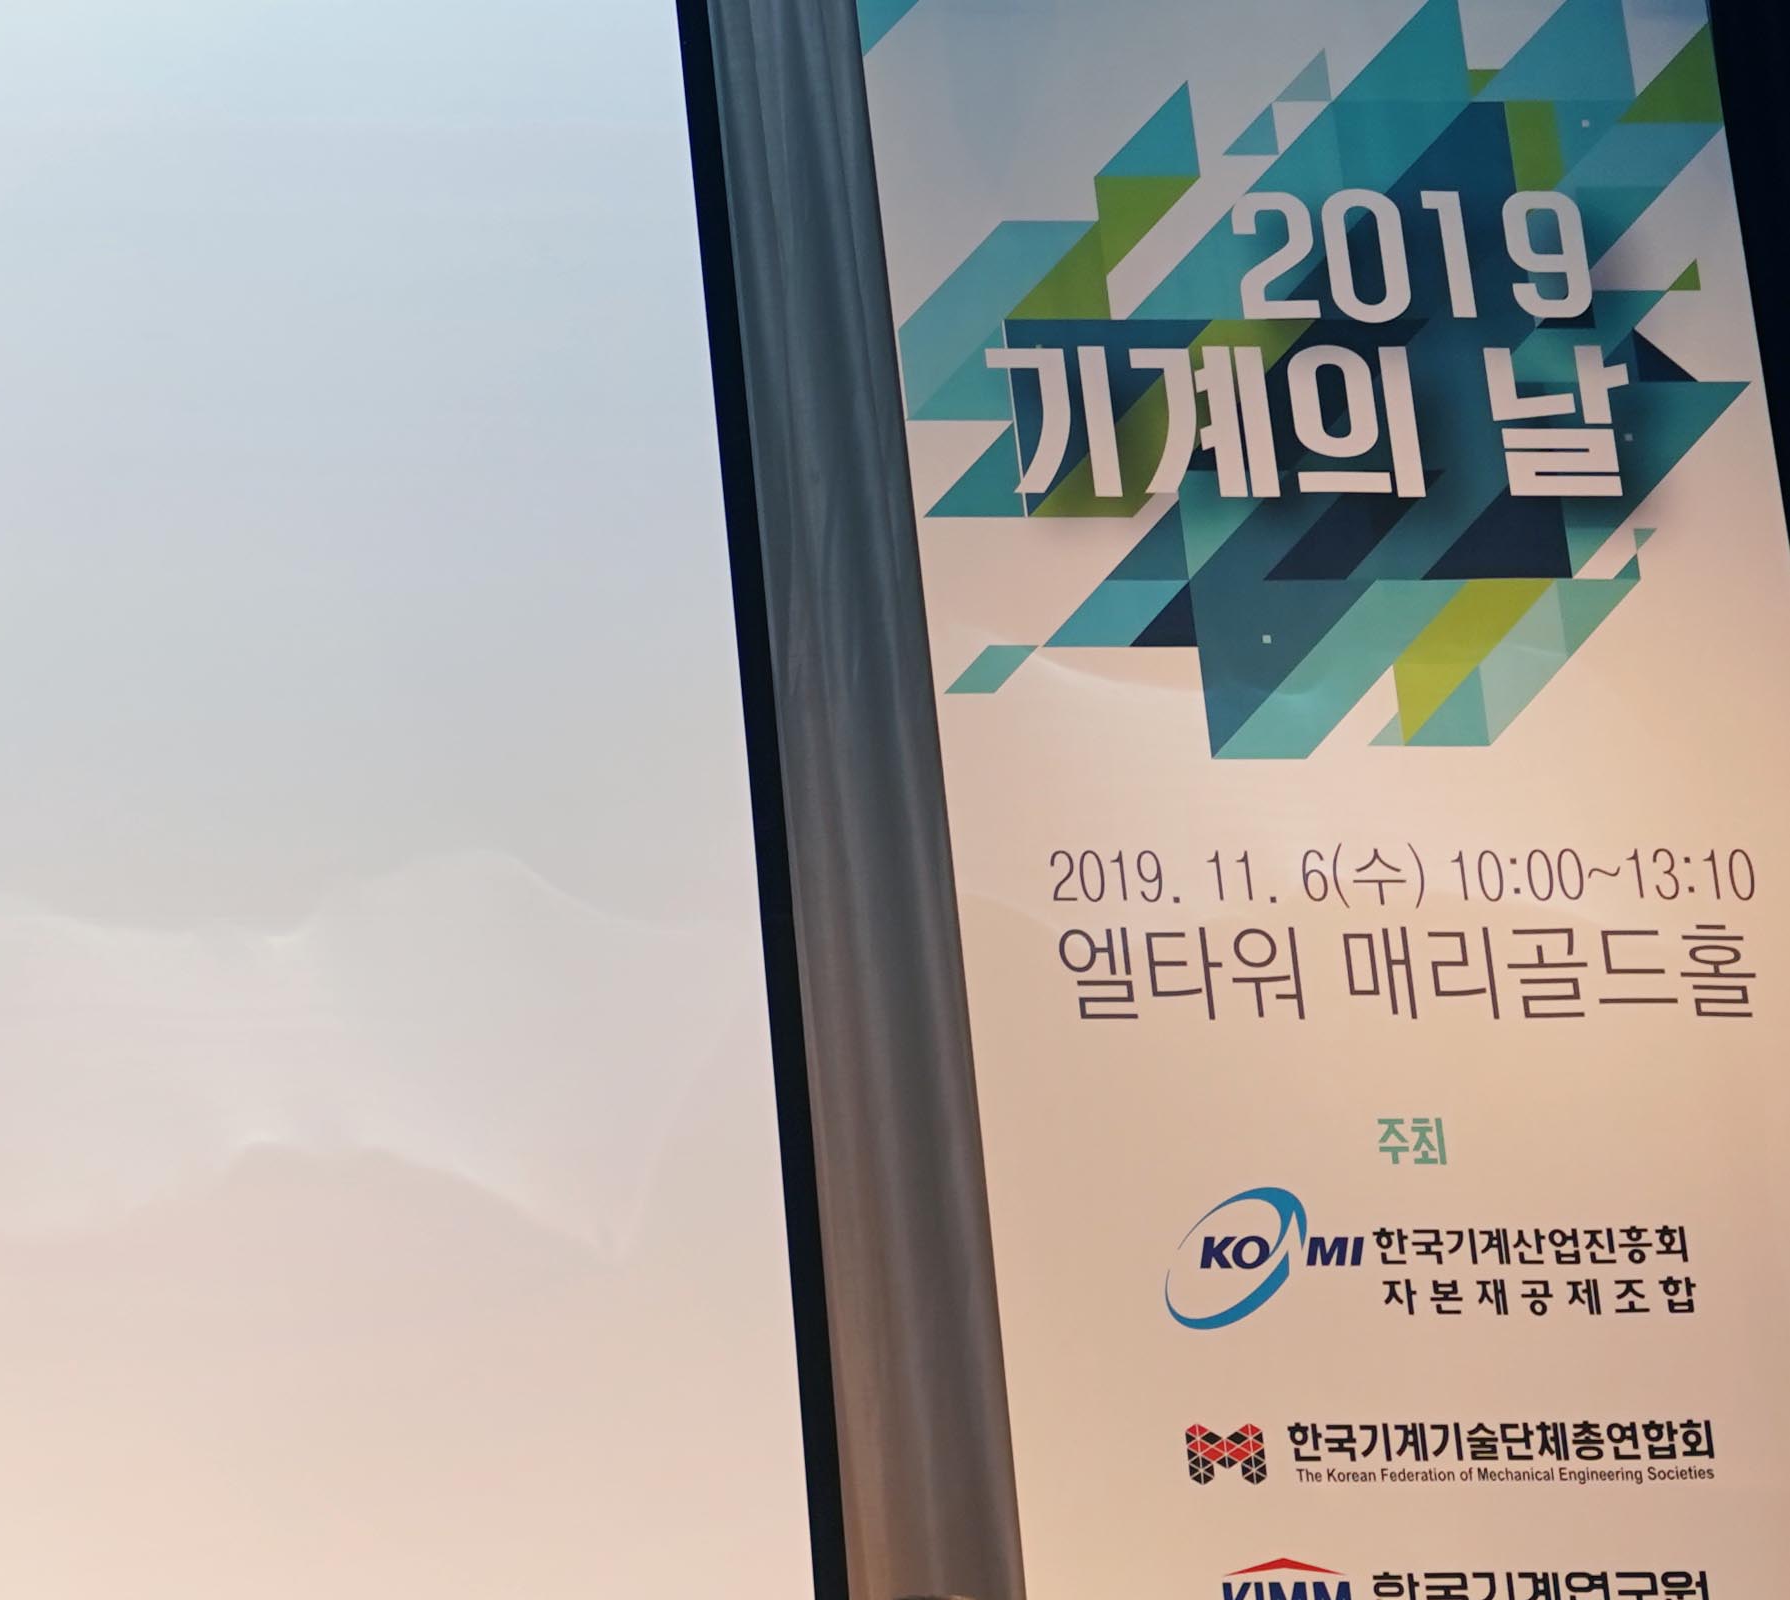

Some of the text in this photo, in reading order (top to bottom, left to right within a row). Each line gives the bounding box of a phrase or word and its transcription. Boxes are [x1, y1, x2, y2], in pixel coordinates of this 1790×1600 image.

[1231, 189, 1594, 323] 2019
[985, 345, 1629, 498] 기계의 날
[1049, 842, 1755, 909] 2019. 11. 6(수) 10:00~13:10
[1058, 923, 1756, 1020] 엘타워 매리골드홀
[1376, 1117, 1447, 1165] 주최
[1372, 1225, 1689, 1265] 한국기계산업진흥회
[1287, 1420, 1715, 1462] 한국기계기술단체총연합회
[1296, 1466, 1715, 1484] The Korean Federation of Mechanical Engineering Societies
